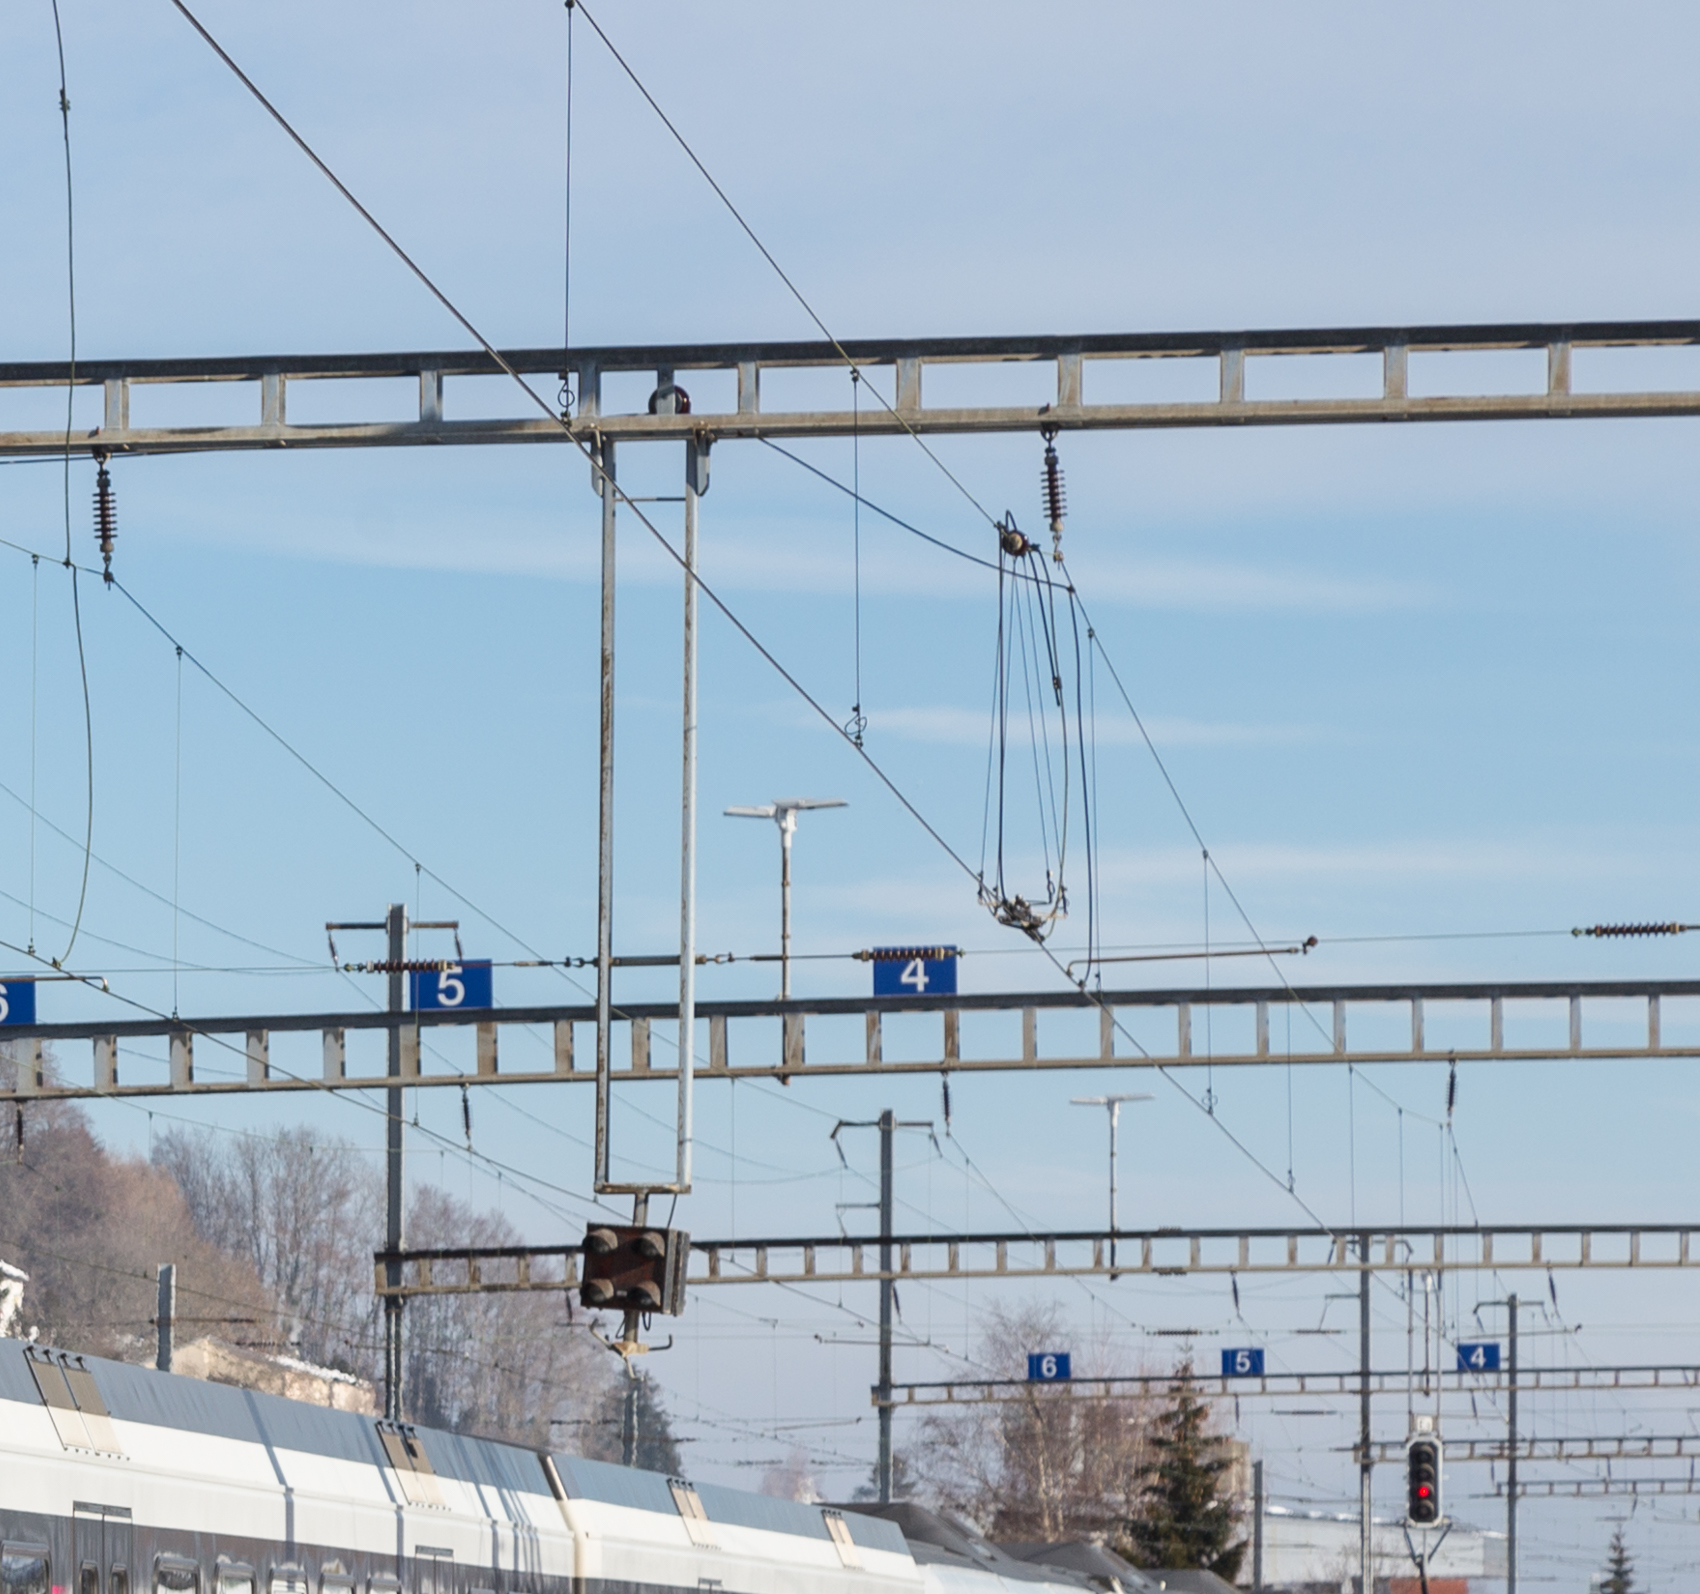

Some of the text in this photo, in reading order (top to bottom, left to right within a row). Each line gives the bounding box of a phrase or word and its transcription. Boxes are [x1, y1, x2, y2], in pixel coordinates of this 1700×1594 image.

[437, 966, 465, 1007] 5
[901, 957, 930, 992] 4
[1041, 1355, 1057, 1379] 6
[1235, 1350, 1250, 1373] 5
[1470, 1345, 1486, 1368] 4
